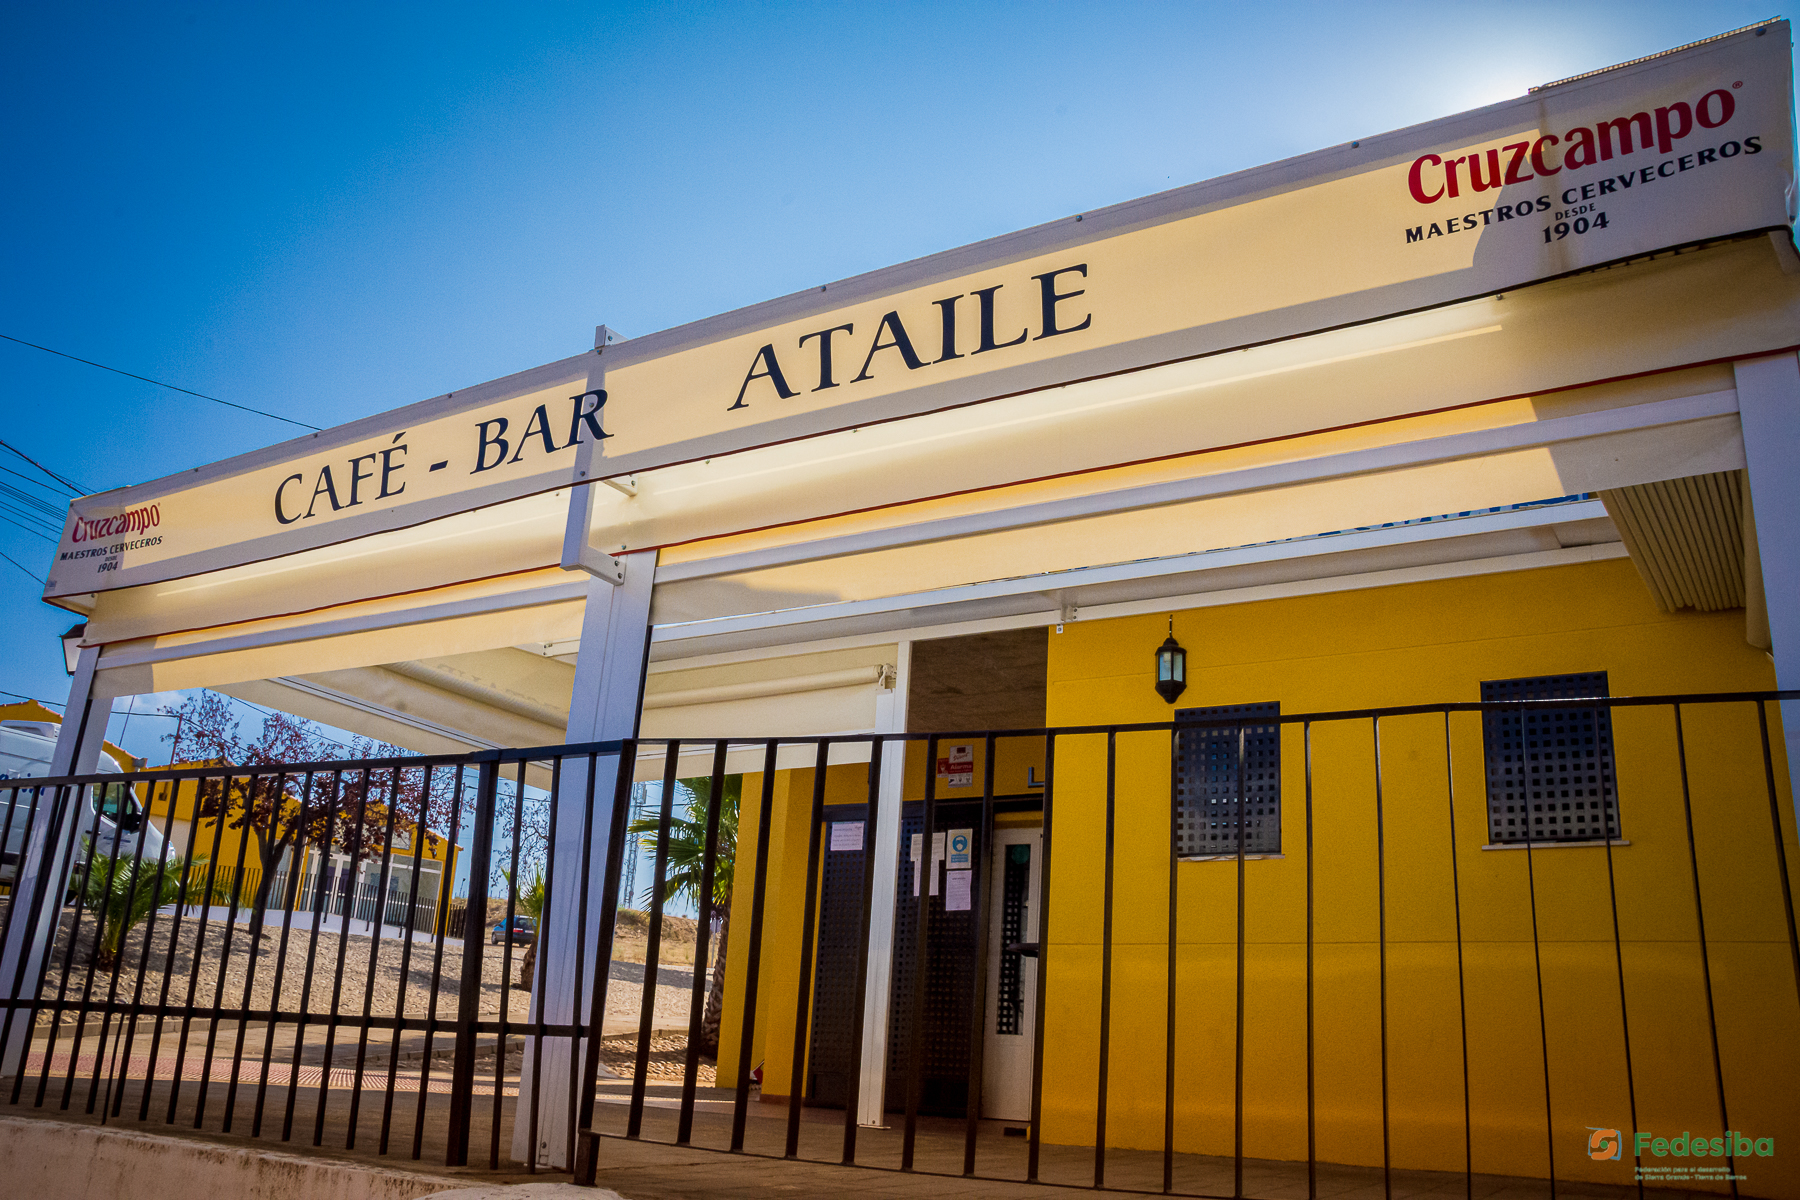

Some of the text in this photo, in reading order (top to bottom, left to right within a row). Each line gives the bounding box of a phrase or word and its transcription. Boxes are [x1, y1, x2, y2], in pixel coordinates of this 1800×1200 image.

[1408, 88, 1735, 205] Cruzcampo
[1405, 135, 1763, 244] MAESTROS CERVECEROS
[1543, 211, 1610, 244] 1904
[1554, 202, 1596, 221] DESDE
[274, 431, 408, 525] CAFÉ
[469, 388, 615, 475] BAR
[727, 263, 1092, 412] ATAILE
[71, 504, 161, 543] Cruzcampo
[60, 536, 163, 561] MAESTROS CERVECEROS
[97, 561, 119, 573] 1904
